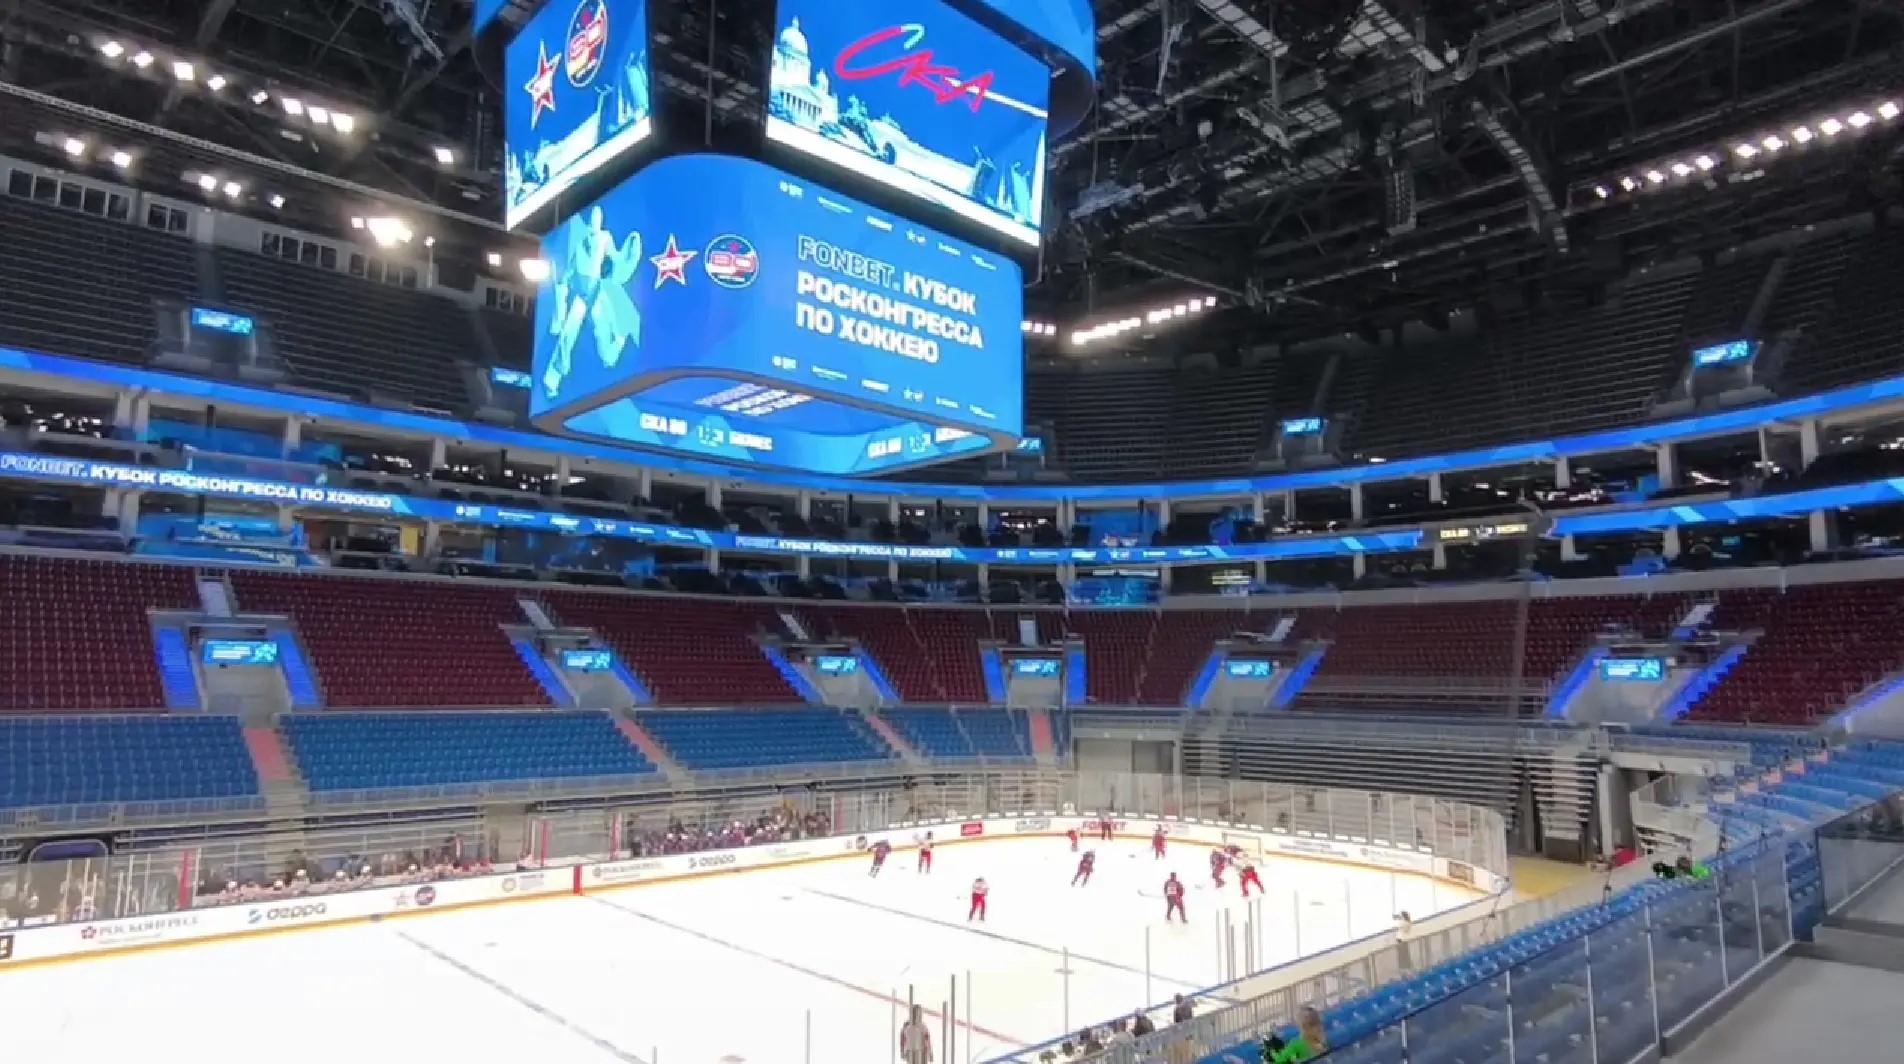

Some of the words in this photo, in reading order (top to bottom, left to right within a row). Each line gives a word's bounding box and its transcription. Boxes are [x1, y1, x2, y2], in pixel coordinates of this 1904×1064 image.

[797, 269, 985, 349] РОСКОНГРЕССА
[798, 234, 900, 291] FONBET.
[903, 270, 977, 316] КУБОК
[796, 301, 834, 335] ПО
[838, 313, 940, 364] ХОККЕЮ
[90, 464, 155, 485] КУБОК
[158, 471, 298, 501] РОСКОНГРЕССА
[302, 487, 323, 502] ПО
